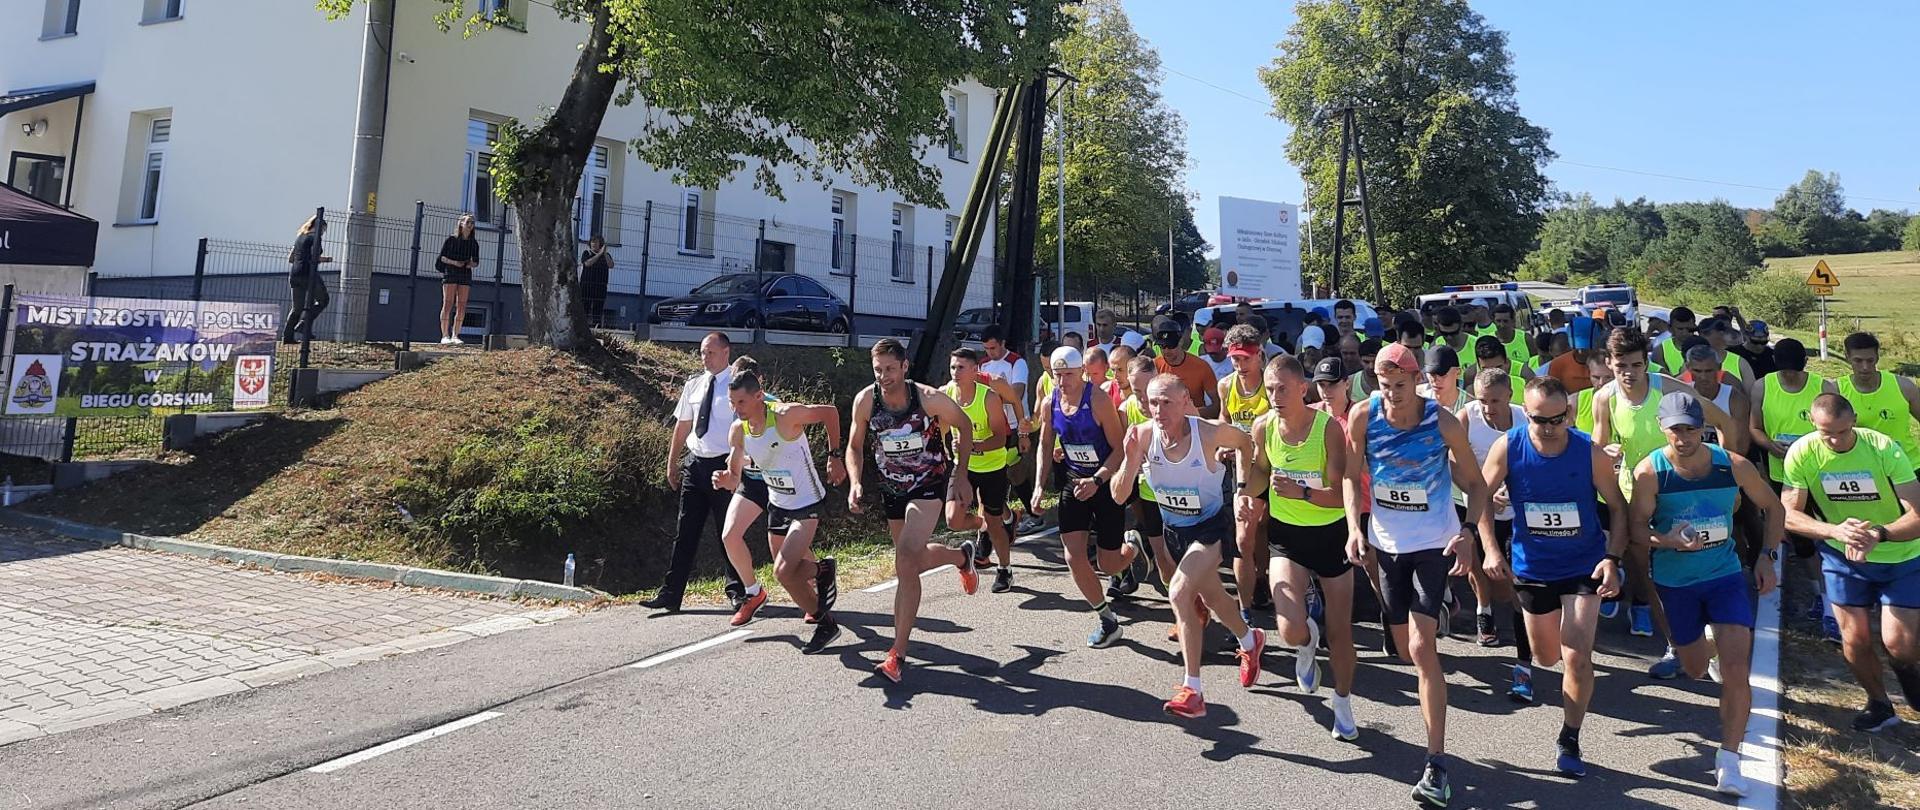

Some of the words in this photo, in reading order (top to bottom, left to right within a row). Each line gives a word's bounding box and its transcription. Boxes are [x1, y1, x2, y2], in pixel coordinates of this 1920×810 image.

[27, 305, 198, 328] MISTRZOSTWA
[203, 311, 272, 329] POLSKI
[70, 337, 232, 361] STRAŻAKÓW
[81, 394, 133, 408] BIEGU
[137, 391, 212, 407] GÓRSKIM
[895, 441, 909, 450] 32
[1074, 451, 1089, 460] 115
[769, 477, 784, 486] 116
[1839, 481, 1860, 492] 48
[1165, 496, 1188, 507] 114
[1390, 491, 1410, 502] 86
[1543, 513, 1562, 526] 33
